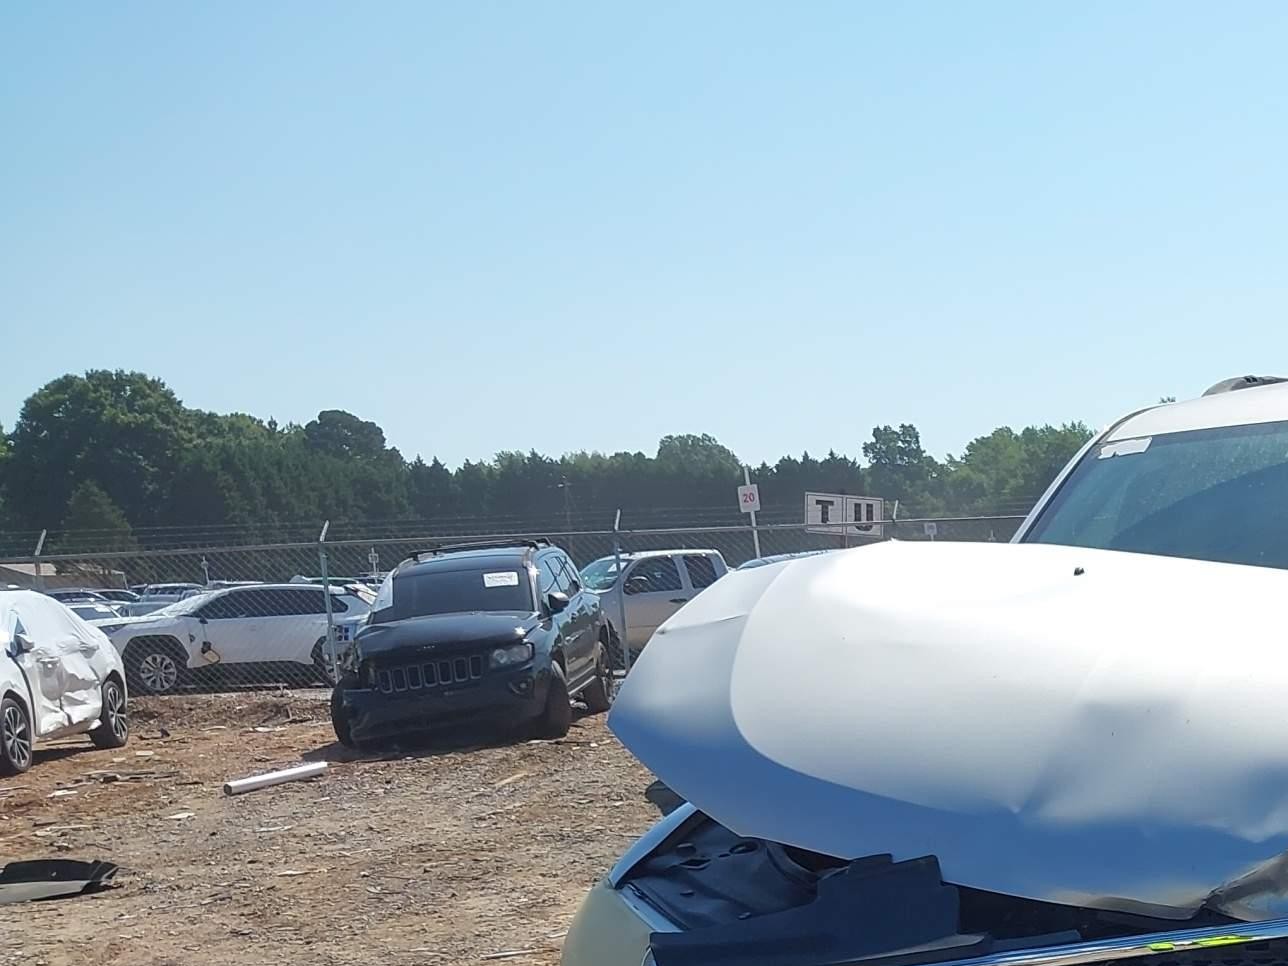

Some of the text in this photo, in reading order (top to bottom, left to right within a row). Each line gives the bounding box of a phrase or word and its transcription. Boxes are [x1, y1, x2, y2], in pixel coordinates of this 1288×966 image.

[743, 493, 755, 503] 20
[815, 500, 874, 531] T U
